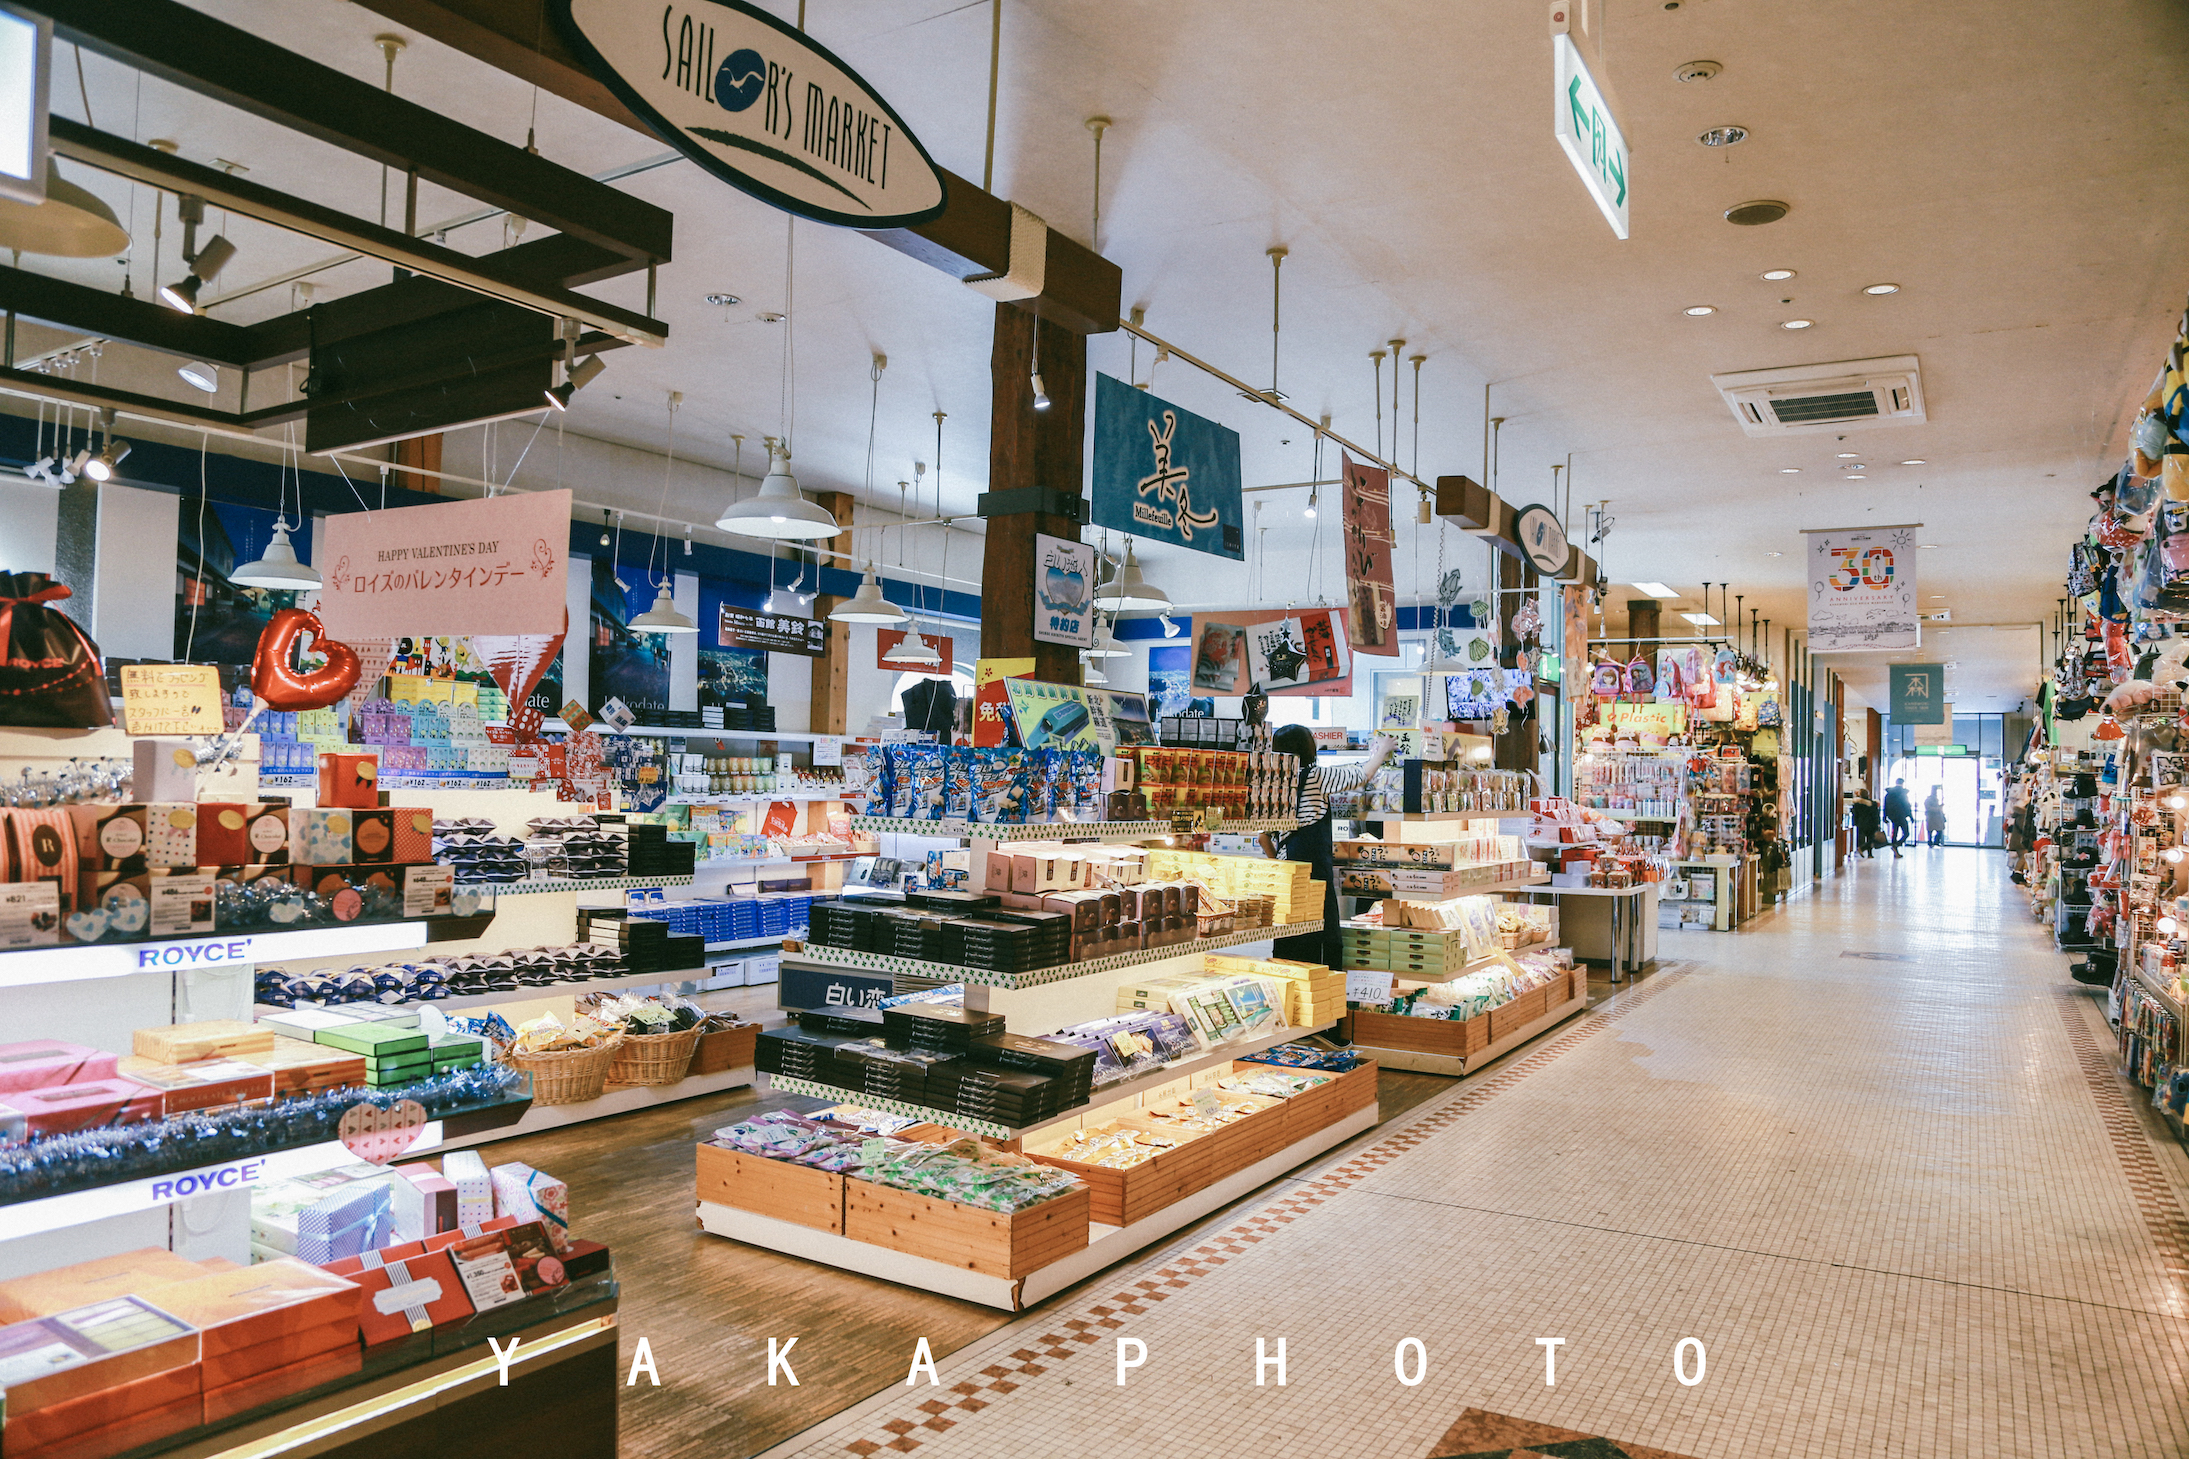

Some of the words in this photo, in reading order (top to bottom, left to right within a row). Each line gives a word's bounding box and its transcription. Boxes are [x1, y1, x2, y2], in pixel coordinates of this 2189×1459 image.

[662, 4, 793, 141] SAILOR'S
[803, 81, 892, 190] MARKET
[1135, 505, 1172, 526] Millefeuille
[377, 549, 409, 562] HAPPY
[412, 543, 475, 559] VALENTINE'S
[478, 540, 500, 554] DAY
[354, 561, 525, 593] ロイズのバレンタインデー
[1829, 546, 1894, 591] 30
[1830, 594, 1894, 602] ANNIVERSARY
[1050, 615, 1080, 634] 特約店
[1155, 707, 1205, 719] Hakodate
[1313, 731, 1343, 740] ASHIER
[1333, 809, 1351, 819] ¥820
[139, 938, 253, 968] ROYCE'
[1353, 986, 1382, 1000] ¥410
[152, 1159, 266, 1201] ROYCE'
